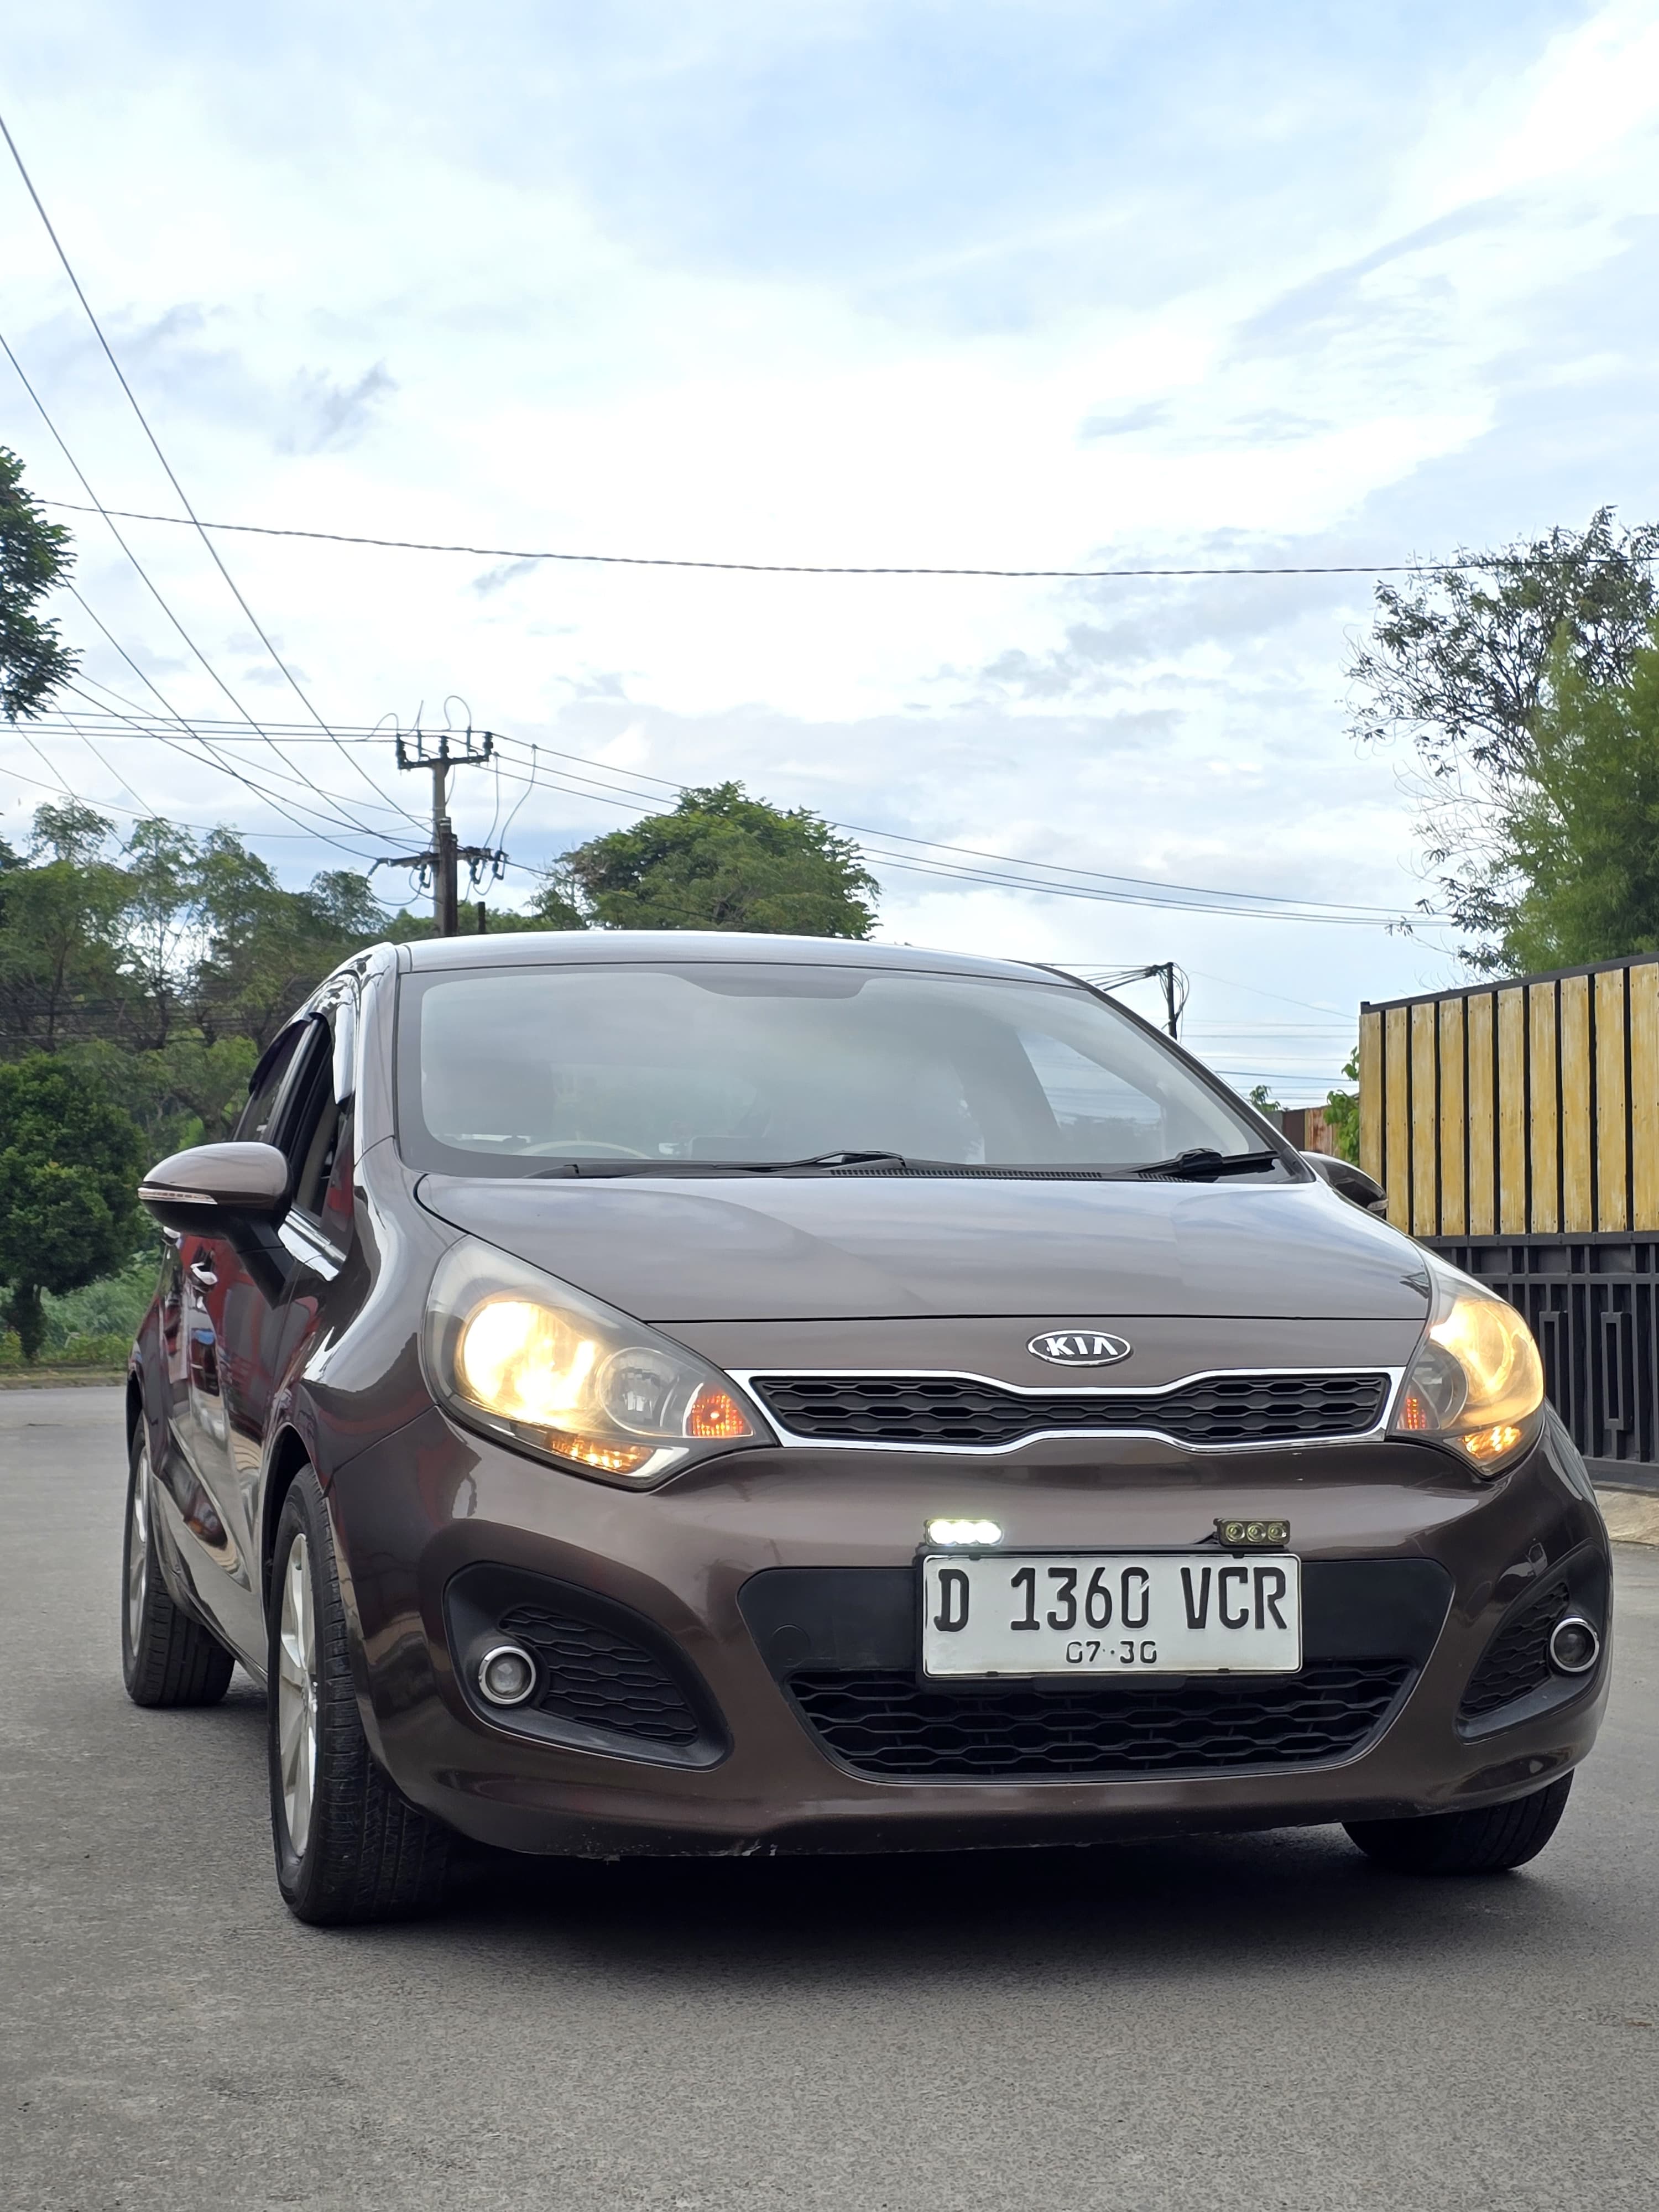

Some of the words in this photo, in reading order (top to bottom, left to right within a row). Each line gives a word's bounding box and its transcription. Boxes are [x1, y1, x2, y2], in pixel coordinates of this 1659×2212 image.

[1044, 1336, 1118, 1357] KIA
[933, 1568, 969, 1632] D
[1010, 1567, 1150, 1631] 1360
[1180, 1567, 1287, 1629] VCR
